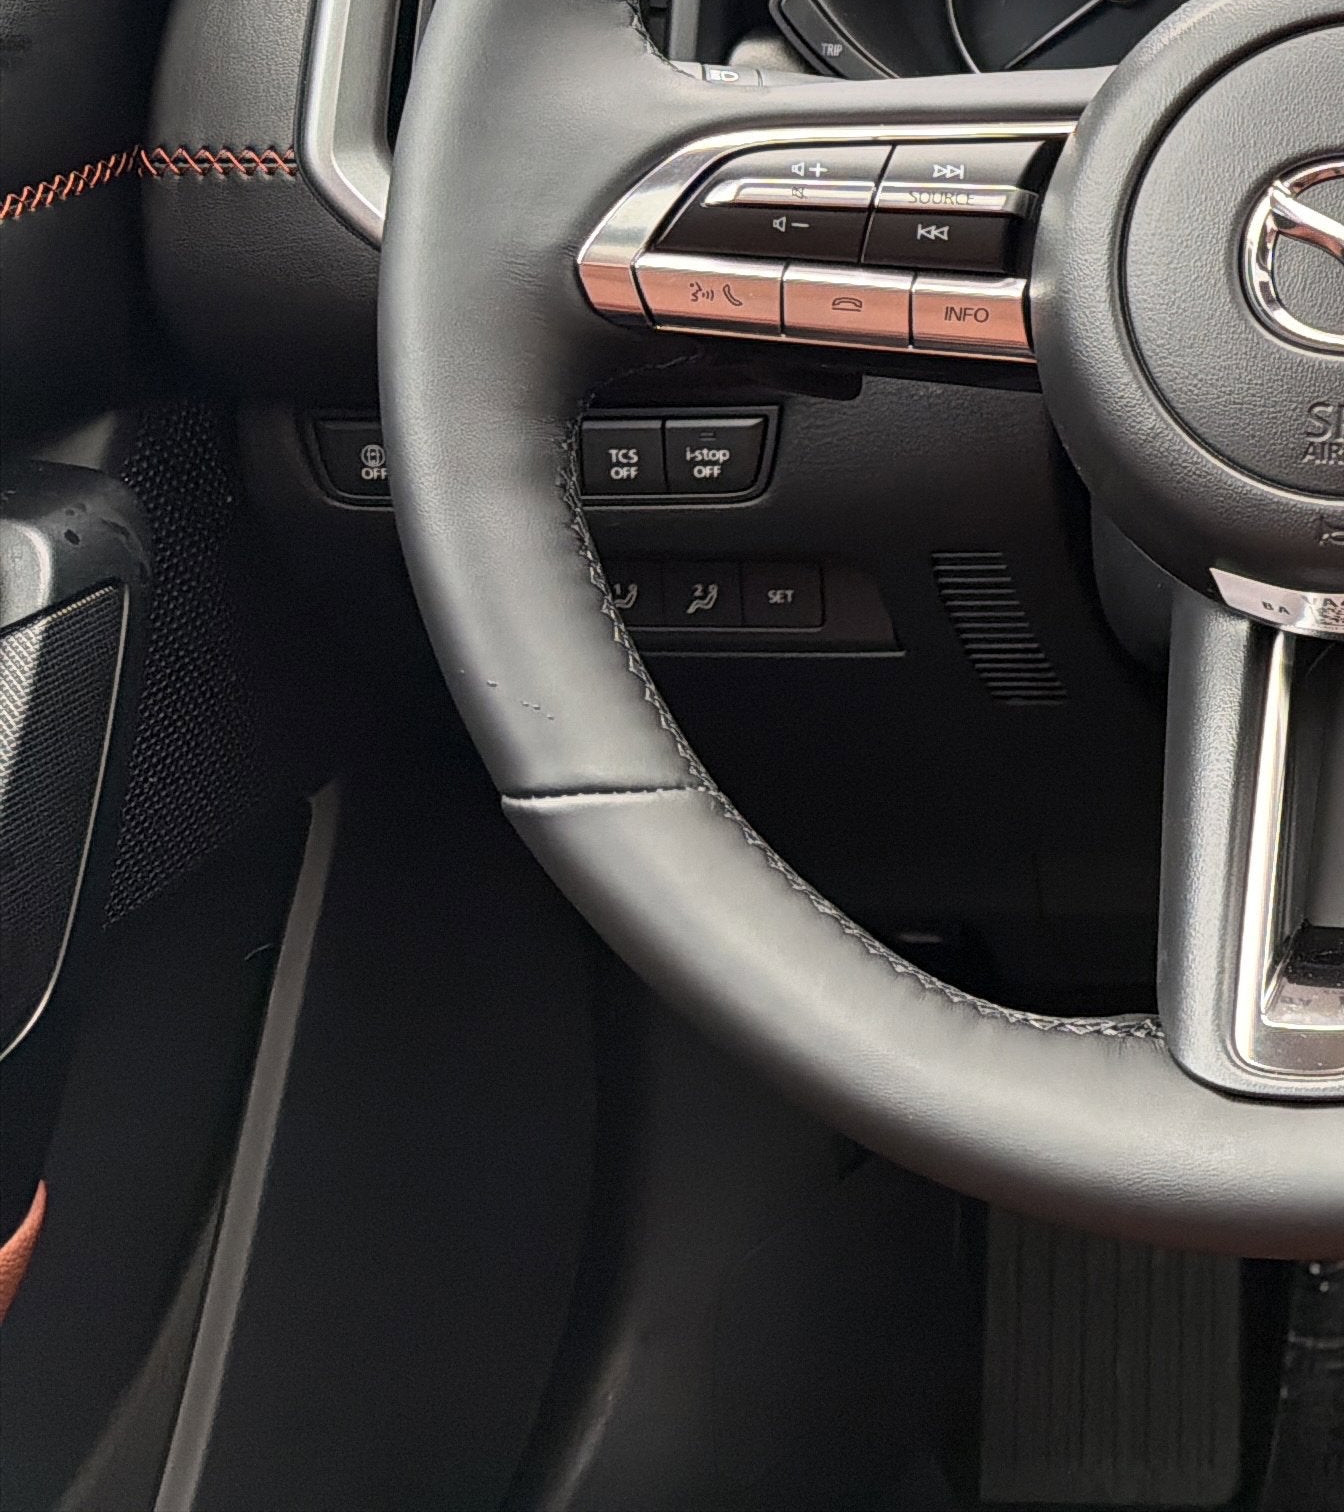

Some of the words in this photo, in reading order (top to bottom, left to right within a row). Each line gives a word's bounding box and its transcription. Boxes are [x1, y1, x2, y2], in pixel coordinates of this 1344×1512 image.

[821, 43, 843, 57] TRIP
[908, 191, 975, 207] SOURCE
[944, 307, 990, 324] INFO
[608, 448, 639, 464] TCS
[686, 447, 730, 466] i-stop
[361, 467, 388, 481] OFF
[609, 465, 639, 480] OFF
[693, 465, 722, 479] OFF
[693, 584, 703, 596] 2
[768, 590, 794, 604] SET
